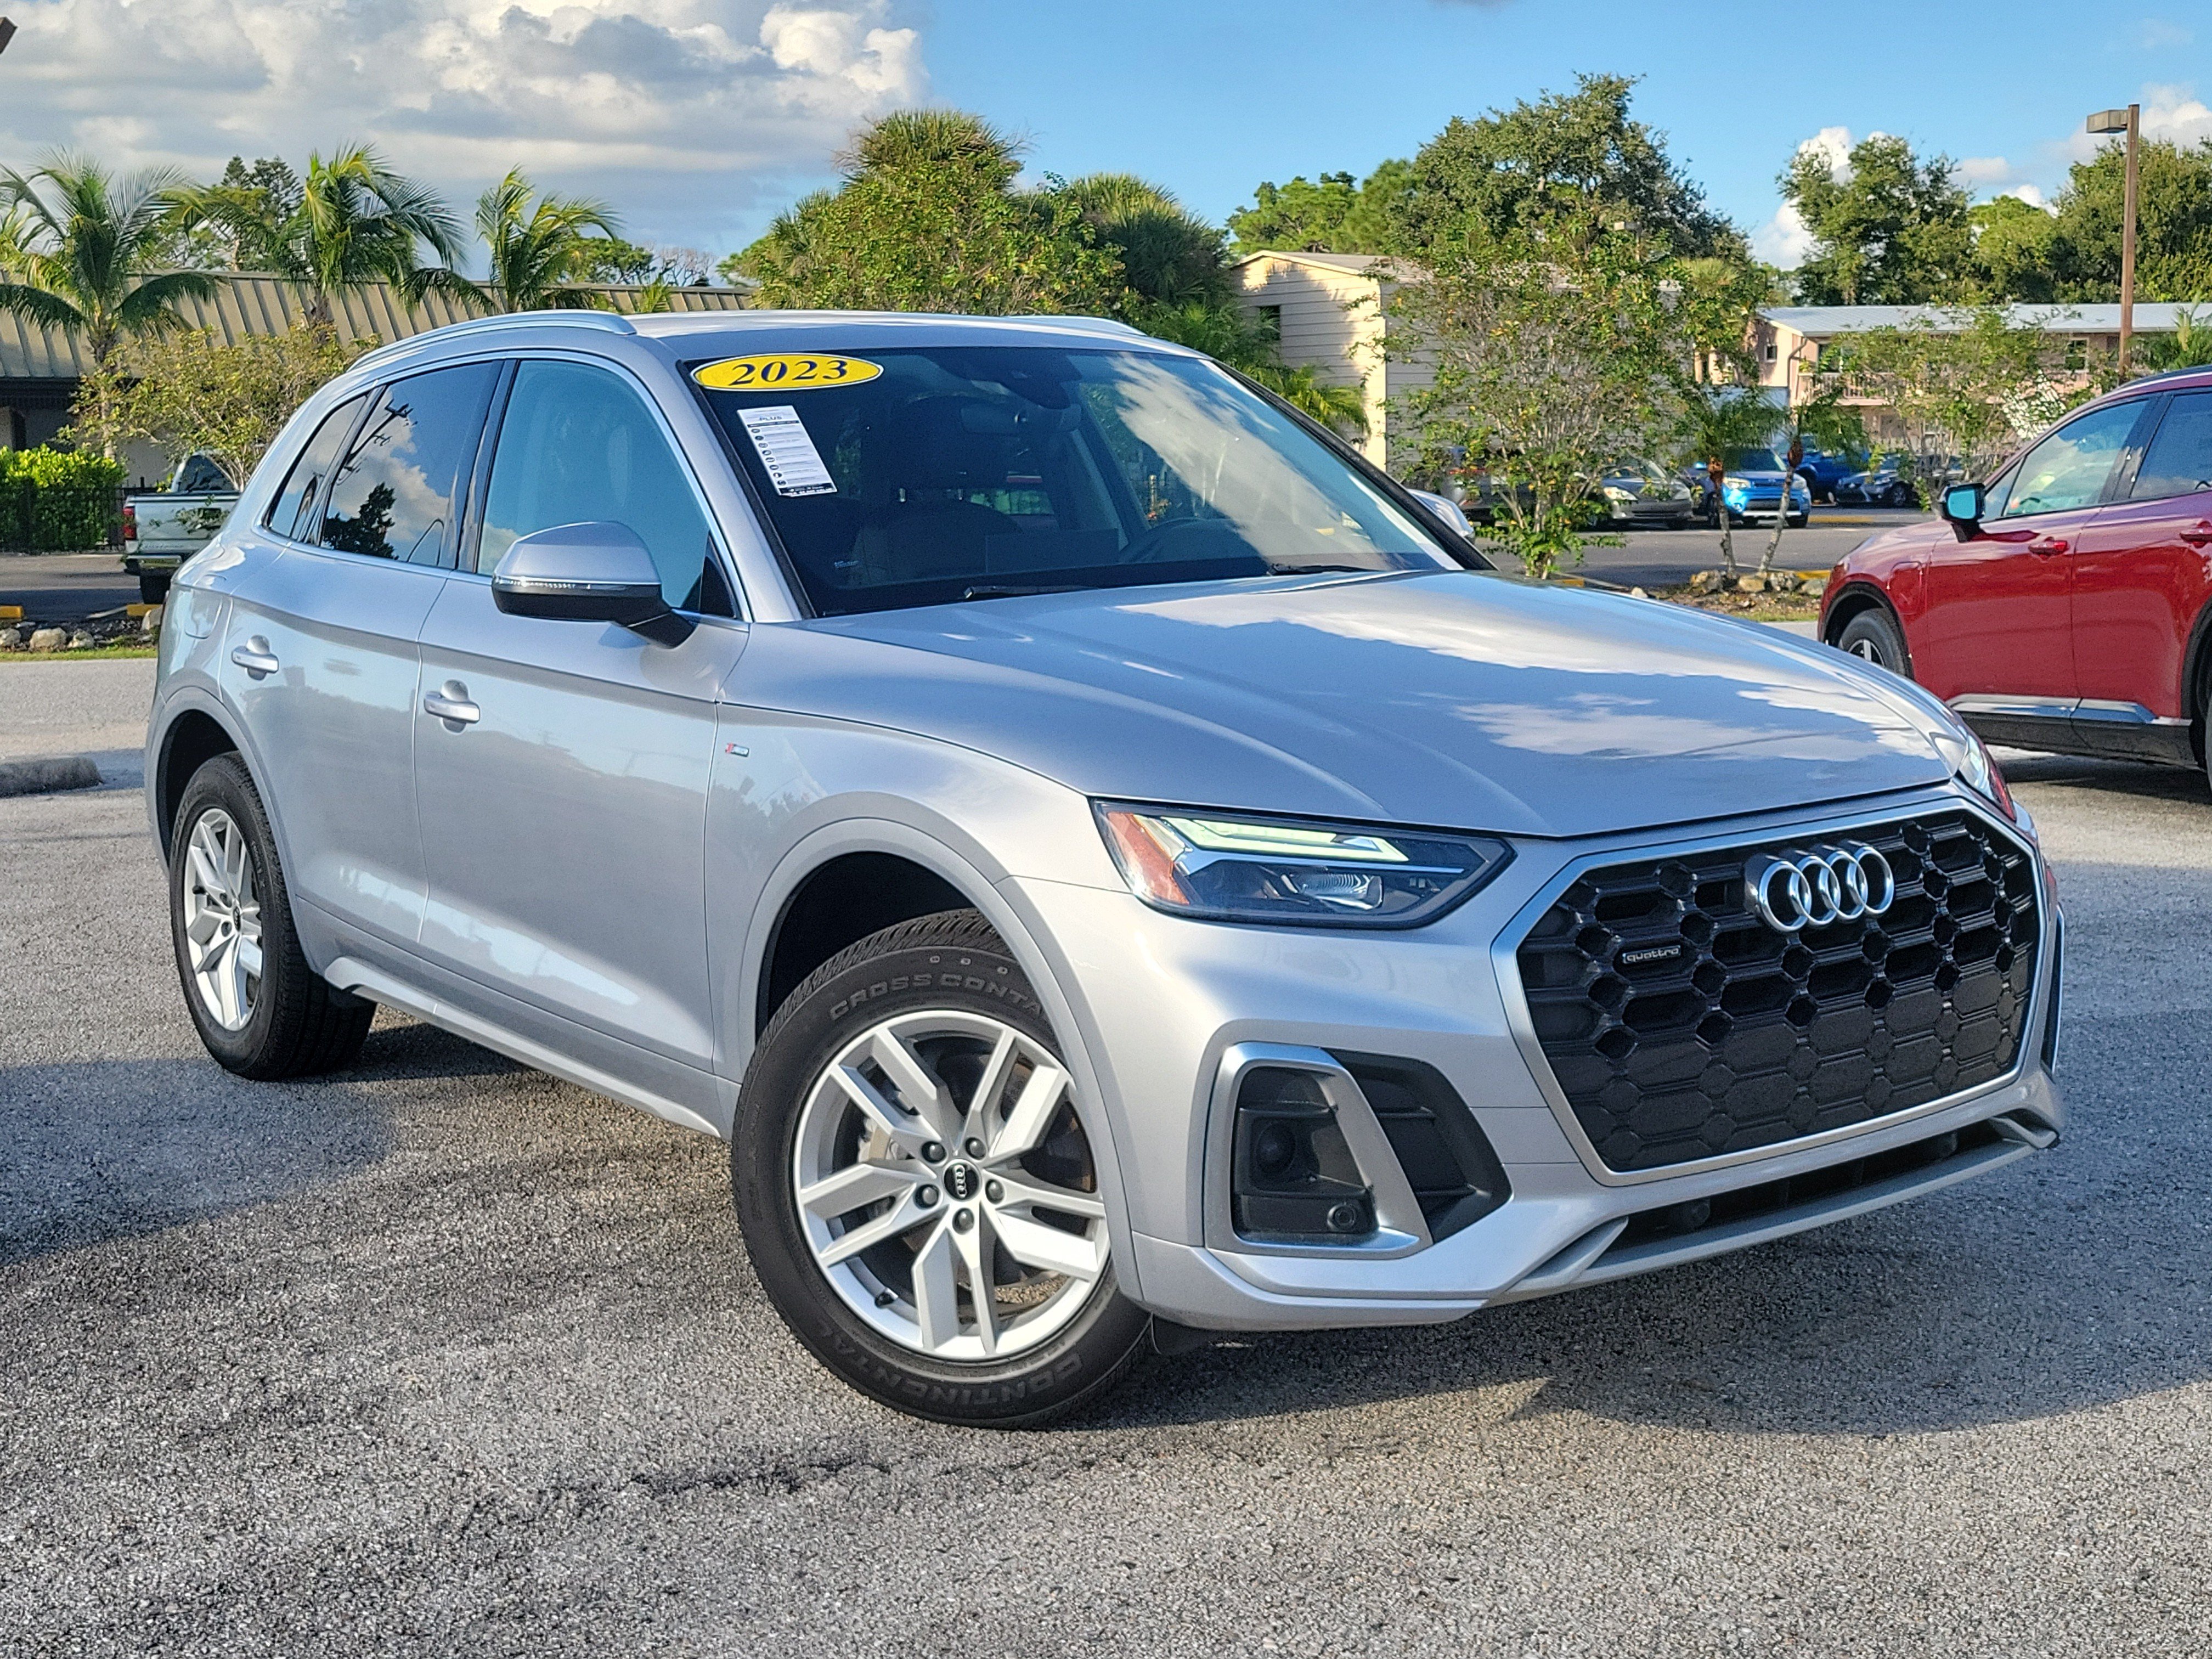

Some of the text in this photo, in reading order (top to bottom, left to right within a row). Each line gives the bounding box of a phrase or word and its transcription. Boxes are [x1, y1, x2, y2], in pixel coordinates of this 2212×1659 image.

[729, 360, 848, 386] 2023
[1627, 948, 1679, 962] quattro
[830, 973, 933, 1020] CROSS
[821, 1323, 1084, 1406] CONTINENTAL
